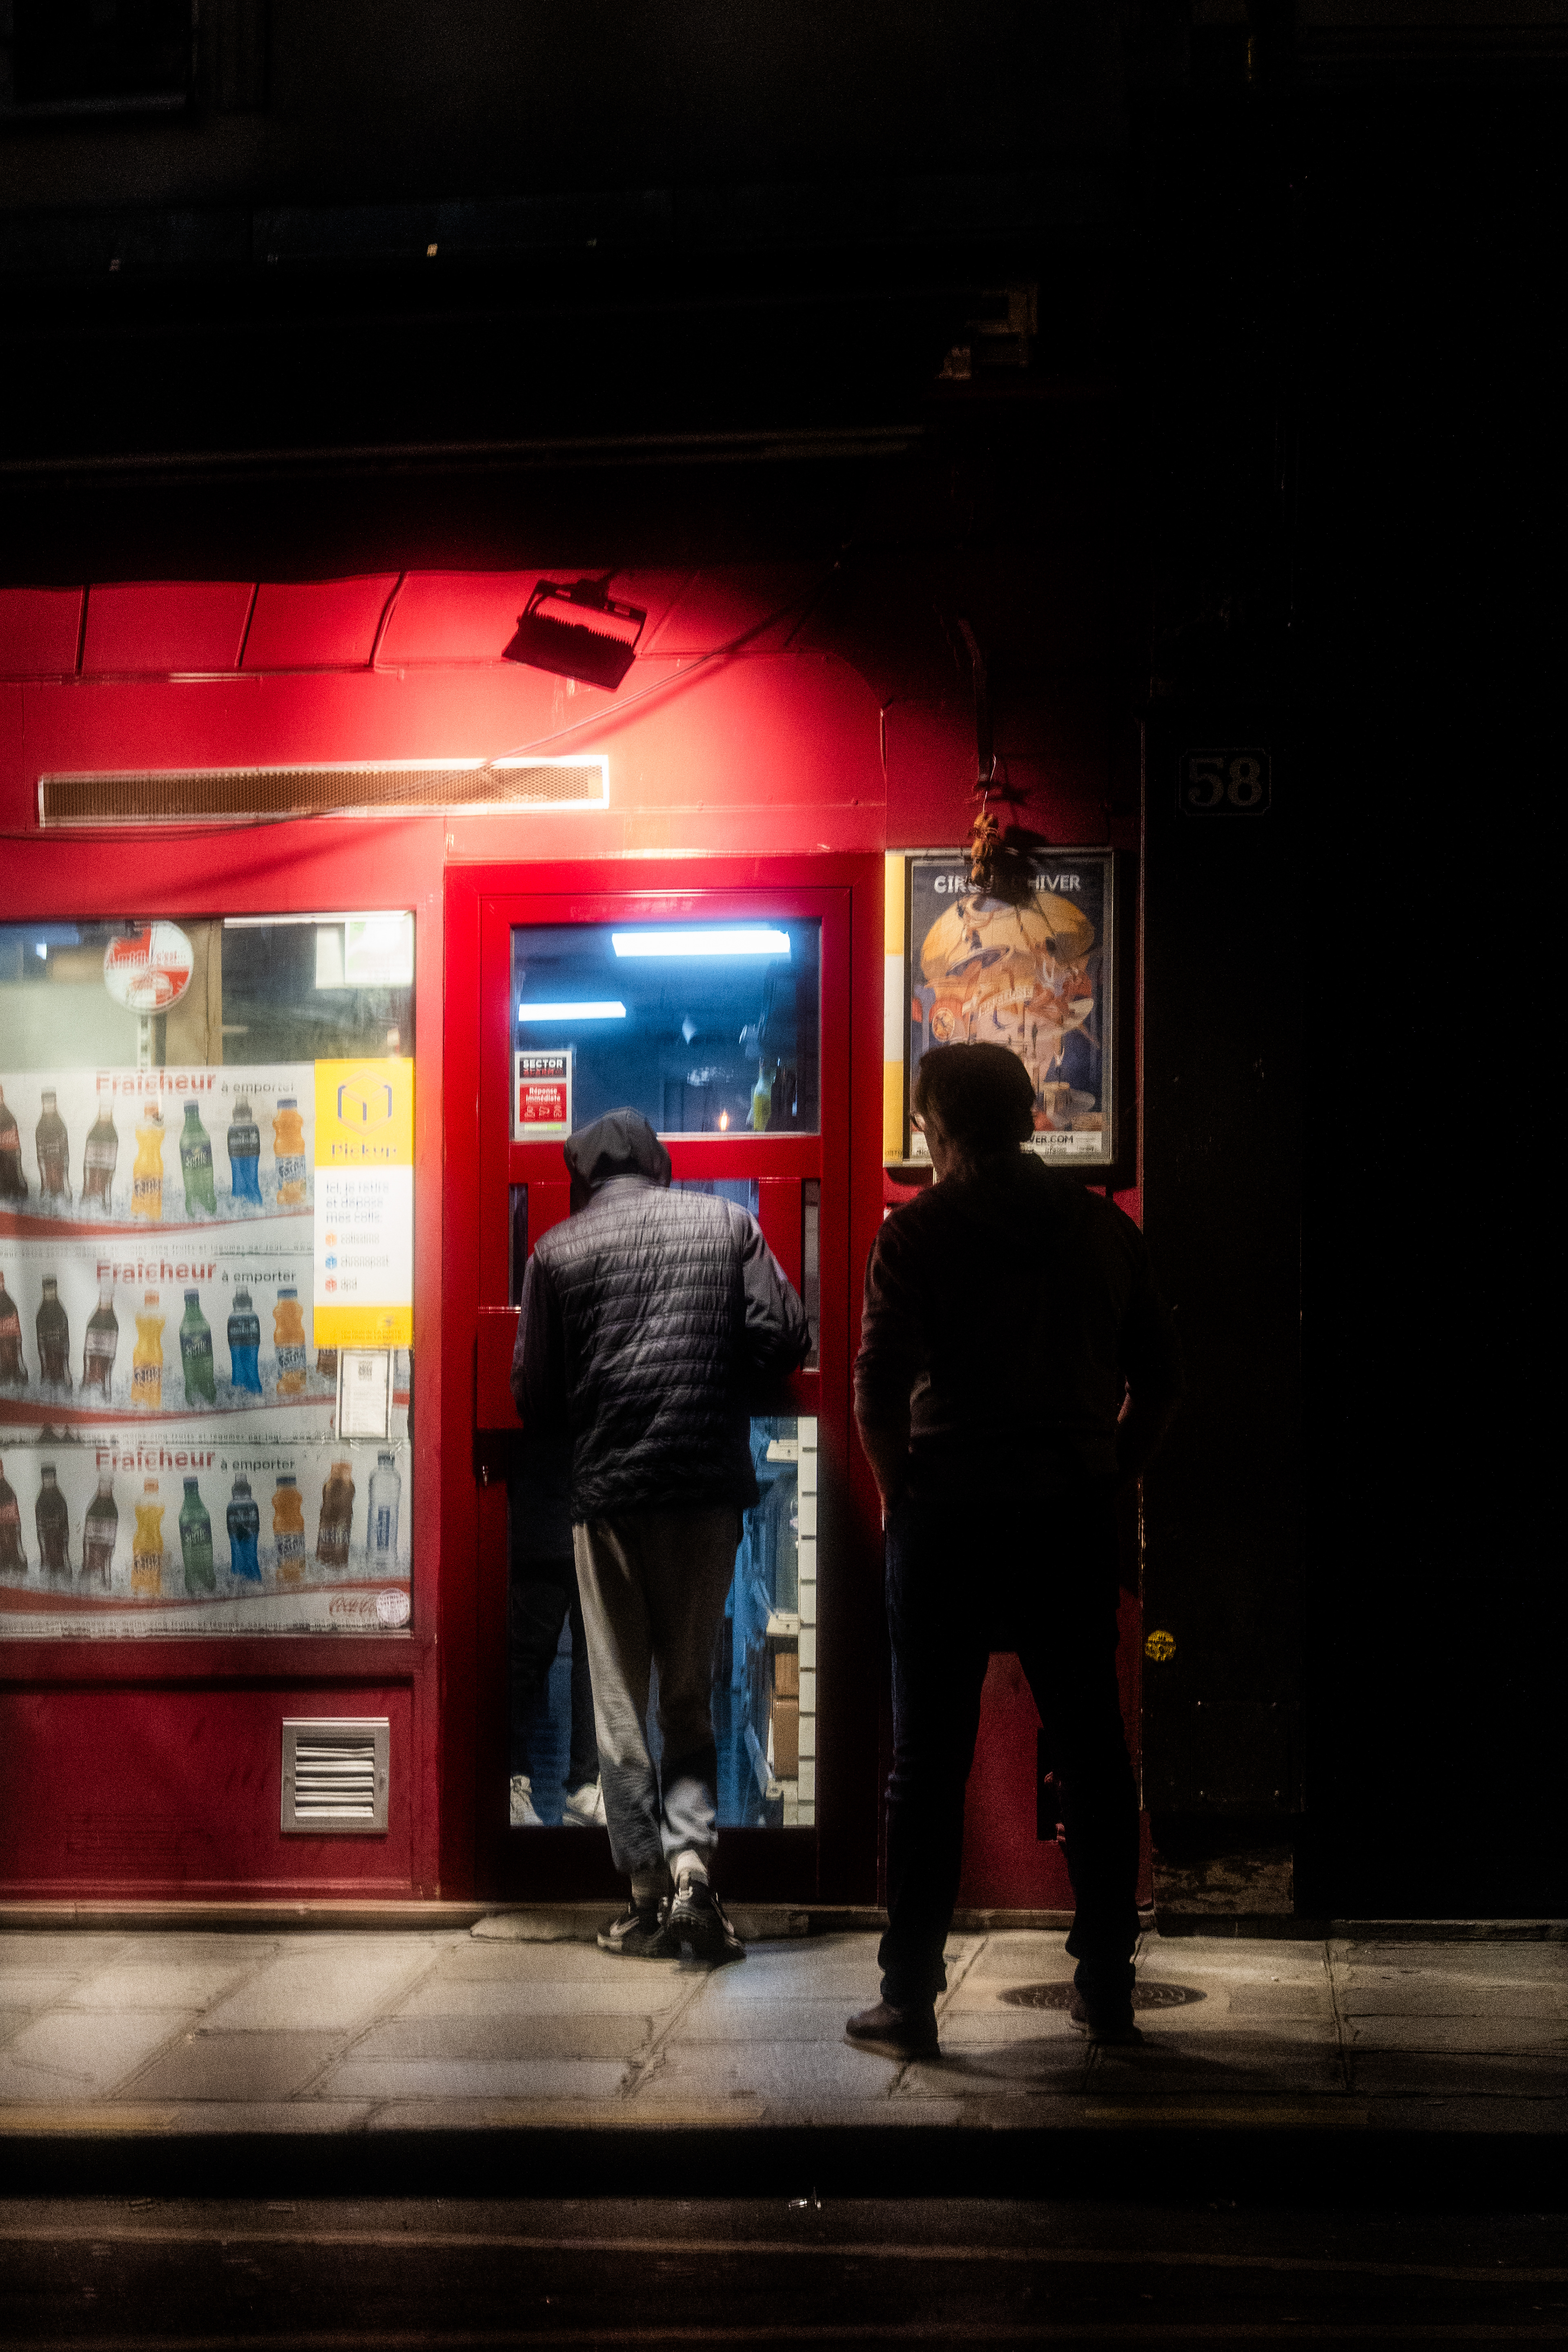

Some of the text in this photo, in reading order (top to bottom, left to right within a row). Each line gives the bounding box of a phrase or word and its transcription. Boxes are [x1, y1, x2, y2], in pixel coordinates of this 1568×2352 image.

[1188, 757, 1263, 806] 58
[1027, 875, 1081, 893] HIVER
[523, 1058, 563, 1069] SECTOR
[96, 1068, 216, 1096] Fraîcheur
[526, 1094, 561, 1103] Immédiate
[529, 1087, 557, 1095] Réponse
[332, 1139, 397, 1161] Pickup
[327, 1179, 341, 1195] Ici,
[359, 1179, 389, 1193] retire
[327, 1211, 351, 1223] mes
[341, 1231, 379, 1245] colissimo
[341, 1254, 390, 1269] chronopost
[97, 1257, 297, 1284] Fraîcheur à emporter
[341, 1277, 357, 1292] dpd
[96, 1446, 295, 1471] Fraîcheur à emporter
